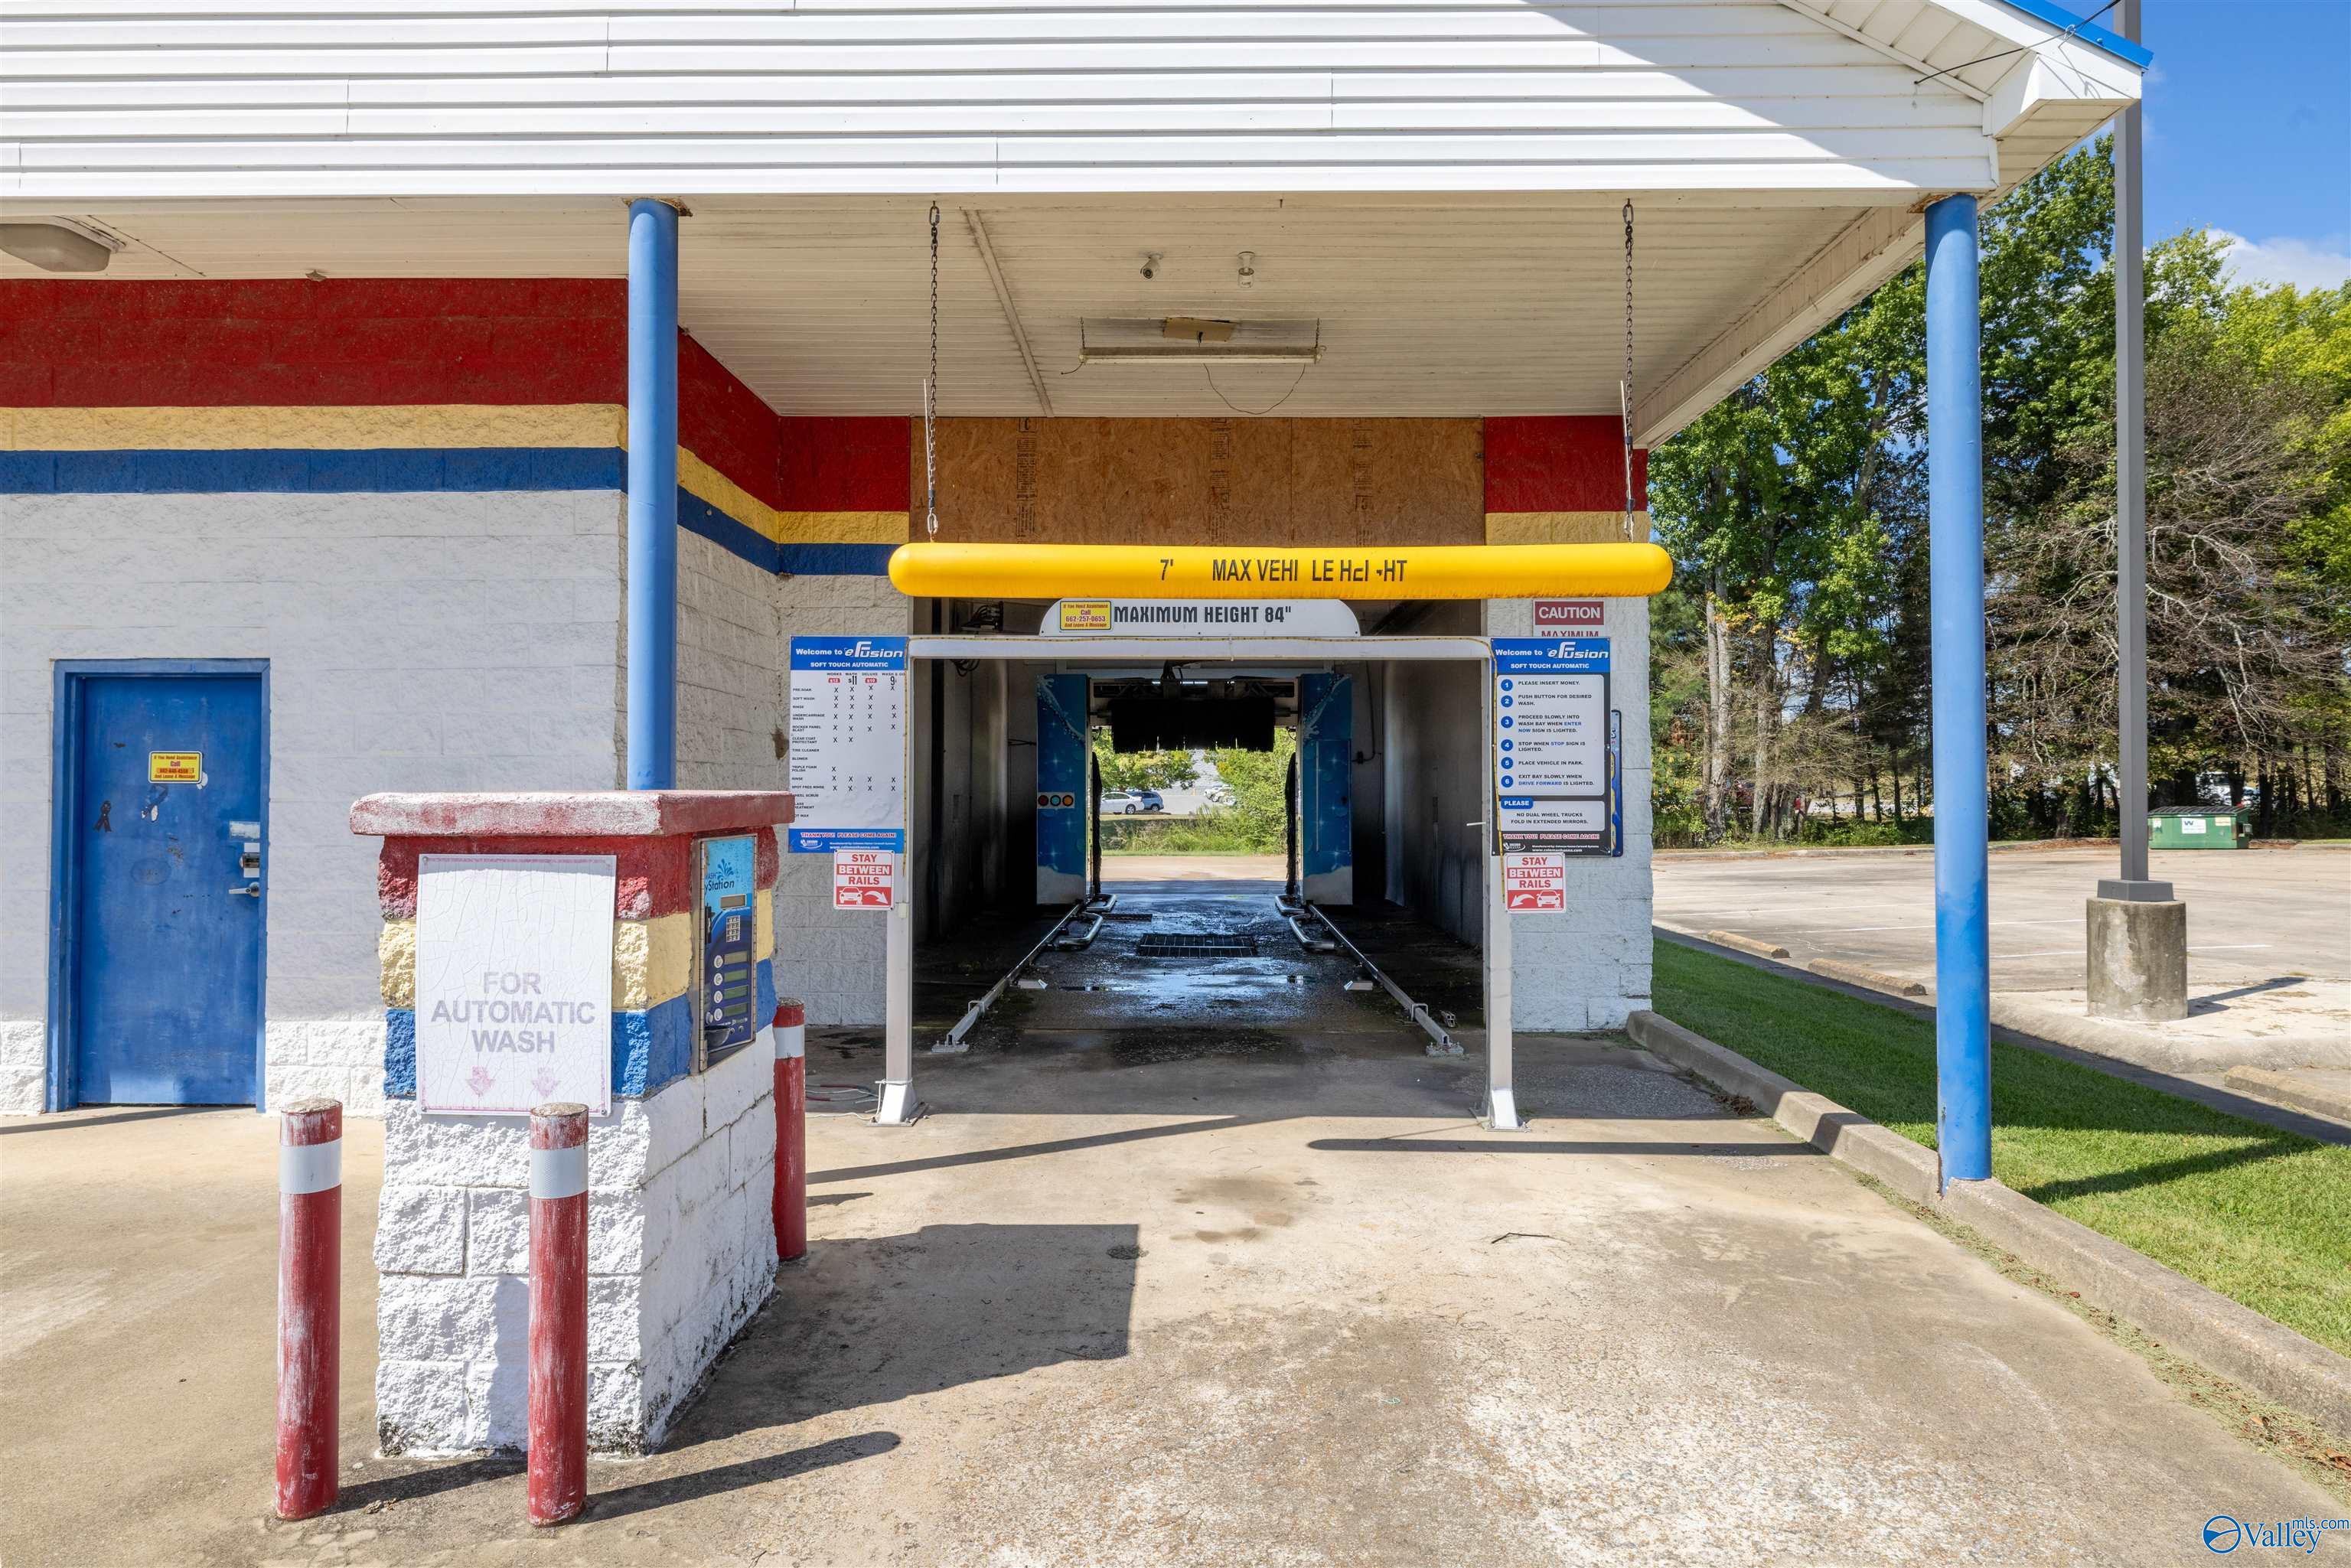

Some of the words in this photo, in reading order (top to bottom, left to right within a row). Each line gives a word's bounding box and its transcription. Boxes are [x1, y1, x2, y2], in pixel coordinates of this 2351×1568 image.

[1160, 559, 1174, 581] 7'
[1213, 559, 1252, 582] MAX
[1257, 559, 1334, 582] VEHILE
[1114, 606, 1197, 623] MAXIMUM
[1205, 606, 1259, 623] HEIGHT
[1265, 606, 1291, 623] 84"
[1539, 607, 1600, 618] CAUTION
[851, 854, 877, 862] STAY
[1522, 857, 1548, 865] STAY
[839, 865, 890, 875] BETWEEN
[1509, 868, 1561, 878] BETWEEN
[848, 876, 880, 885] RAILS
[1519, 880, 1551, 888] RAILS
[483, 972, 541, 994] FOR
[431, 1000, 595, 1024] AUTOMATIC
[472, 1030, 555, 1053] WASH
